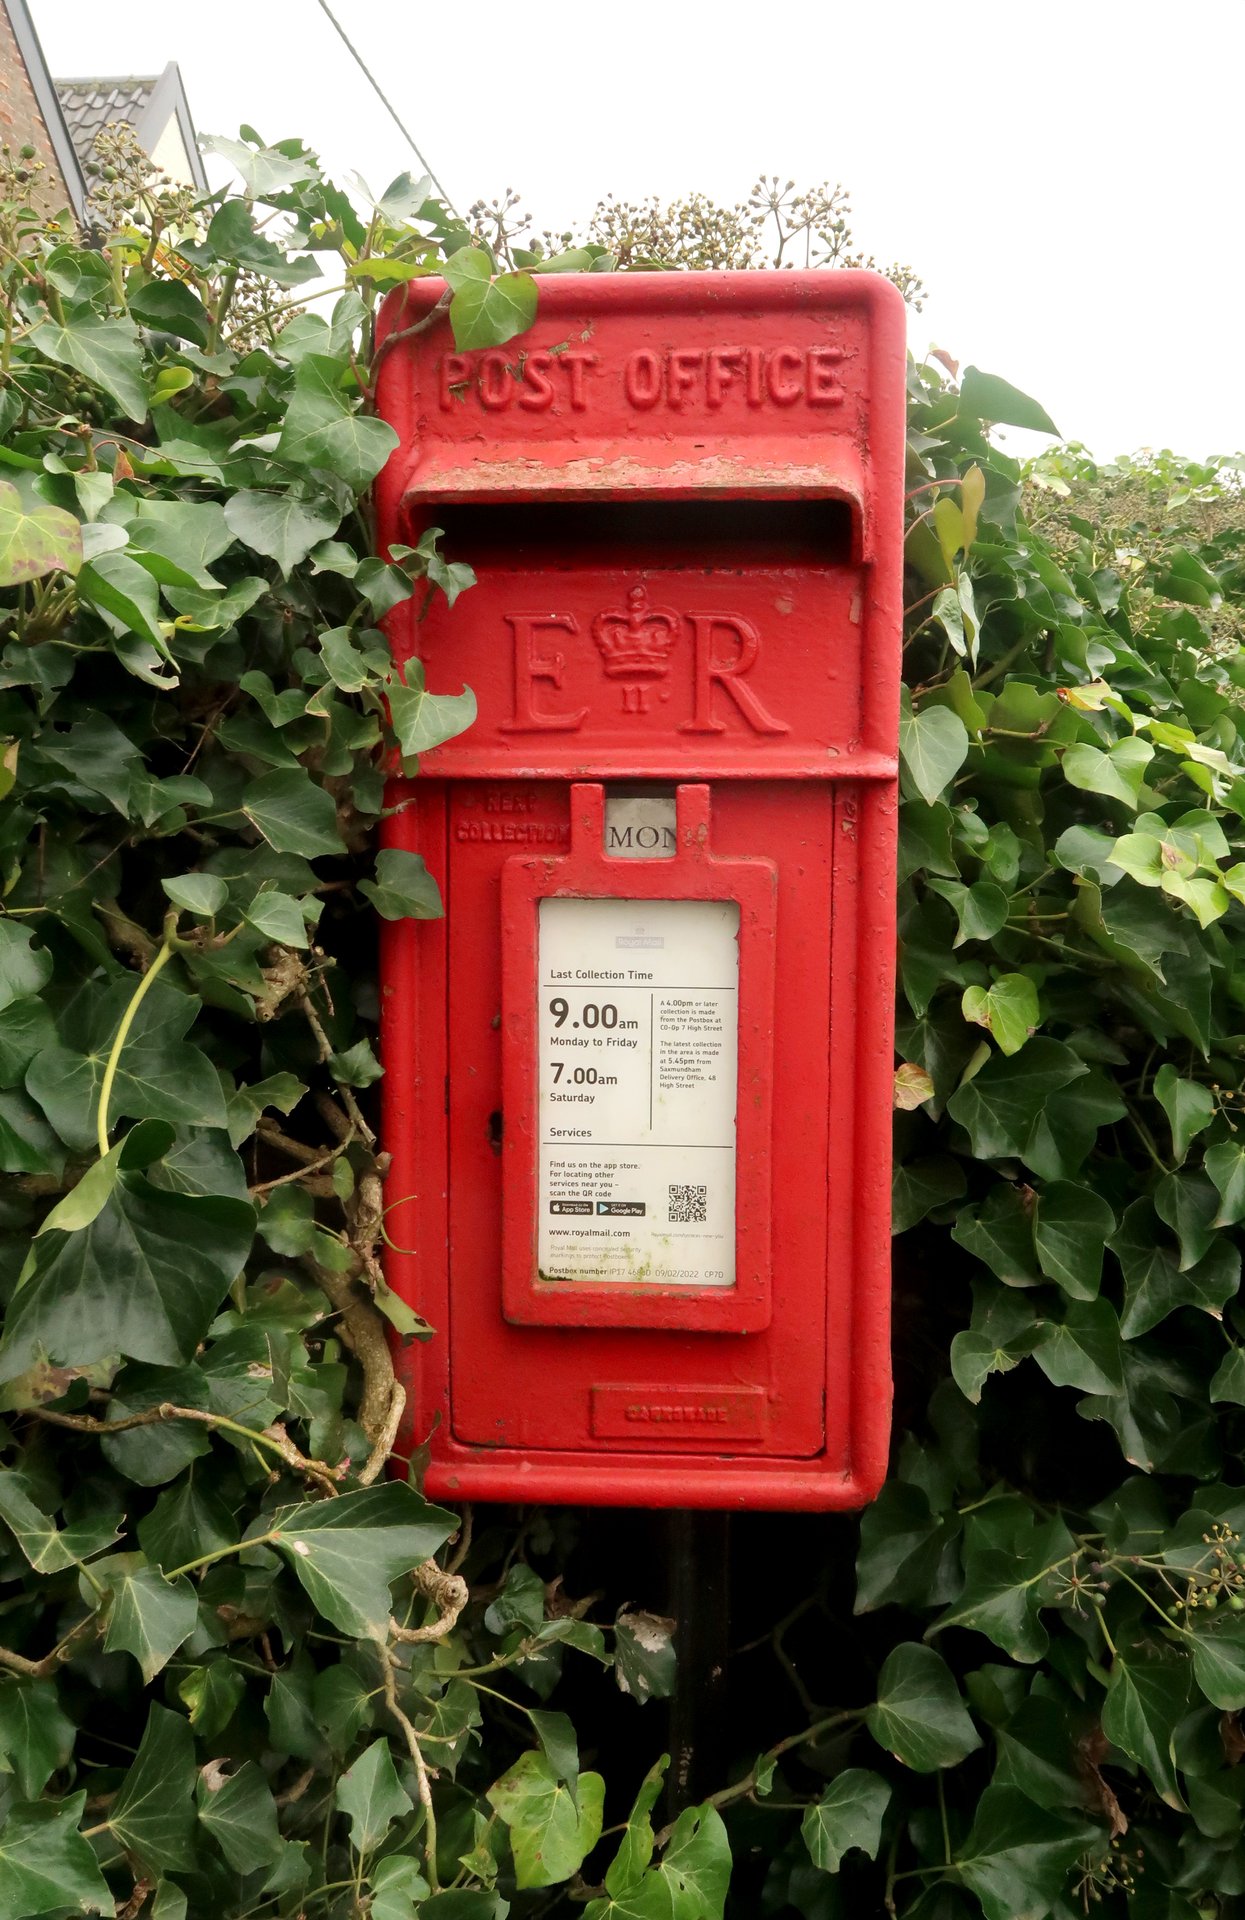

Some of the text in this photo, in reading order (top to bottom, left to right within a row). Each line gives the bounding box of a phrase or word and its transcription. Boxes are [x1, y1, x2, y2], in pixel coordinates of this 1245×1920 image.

[437, 345, 846, 412] POST OFFICE
[498, 610, 791, 735] E R
[550, 969, 654, 980] Last Collection Time
[549, 997, 638, 1030] 9.00am
[550, 1037, 638, 1048] Monday to Friday
[550, 1062, 618, 1086] 7.00am
[550, 1093, 596, 1104] Saturday
[550, 1127, 592, 1137] Services
[549, 1229, 631, 1238] www.royalmail.com
[655, 1270, 699, 1278] 09/02/2022
